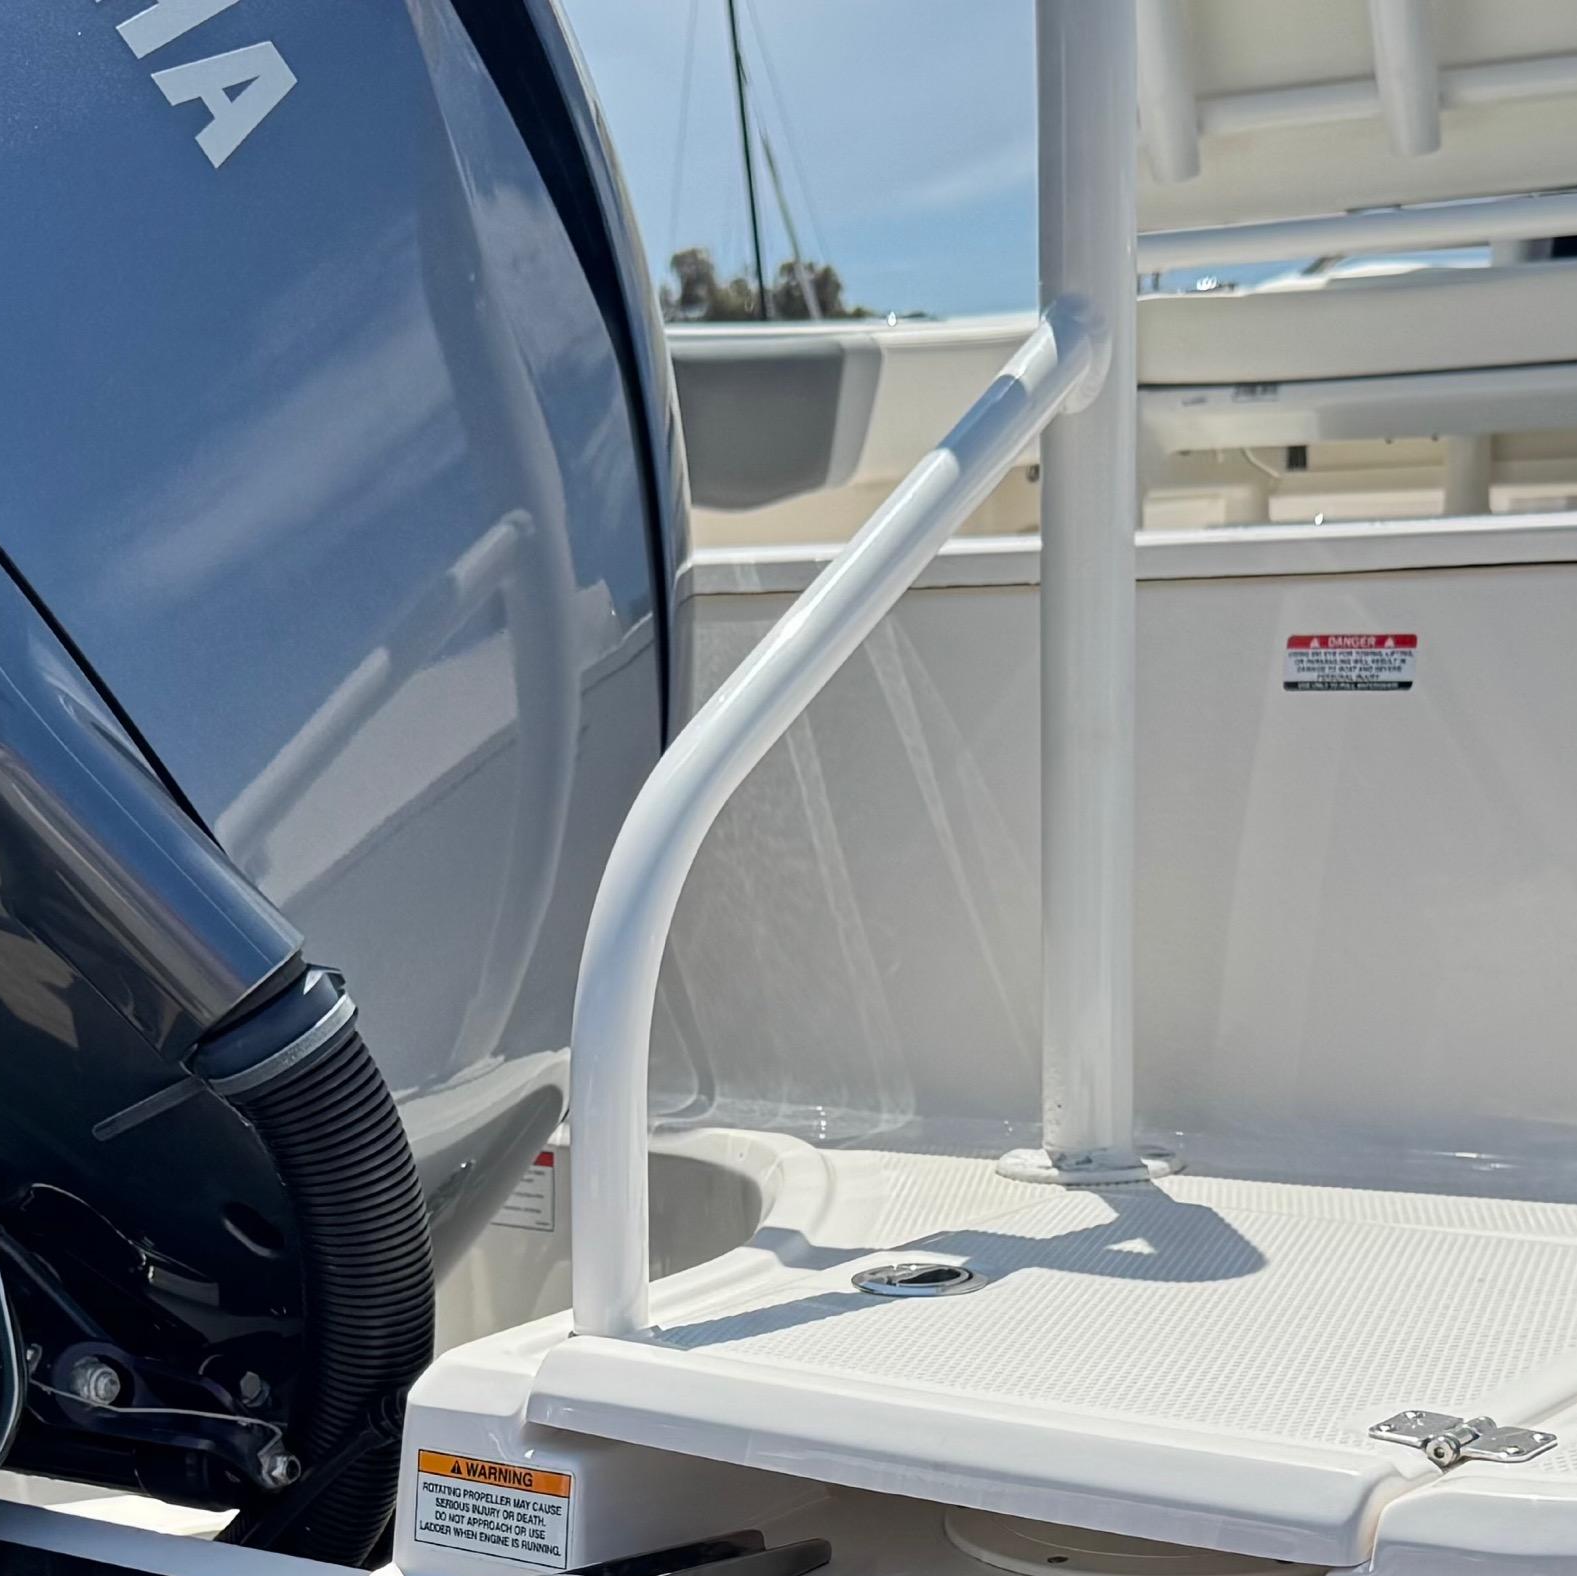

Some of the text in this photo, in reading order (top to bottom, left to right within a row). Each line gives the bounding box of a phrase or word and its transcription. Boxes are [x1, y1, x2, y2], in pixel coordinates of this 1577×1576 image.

[1327, 636, 1376, 649] DANGER
[466, 1461, 533, 1487] WARNING
[422, 1482, 562, 1516] ROTATING PROPELLER MAY CAUSE
[435, 1497, 546, 1527] SERIOUS INJURY OR DEATH.
[419, 1520, 562, 1557] LADDER WHEN ENGINE IS RUNNING.
[435, 1511, 546, 1540] DO NOT APPROACH OR USE
